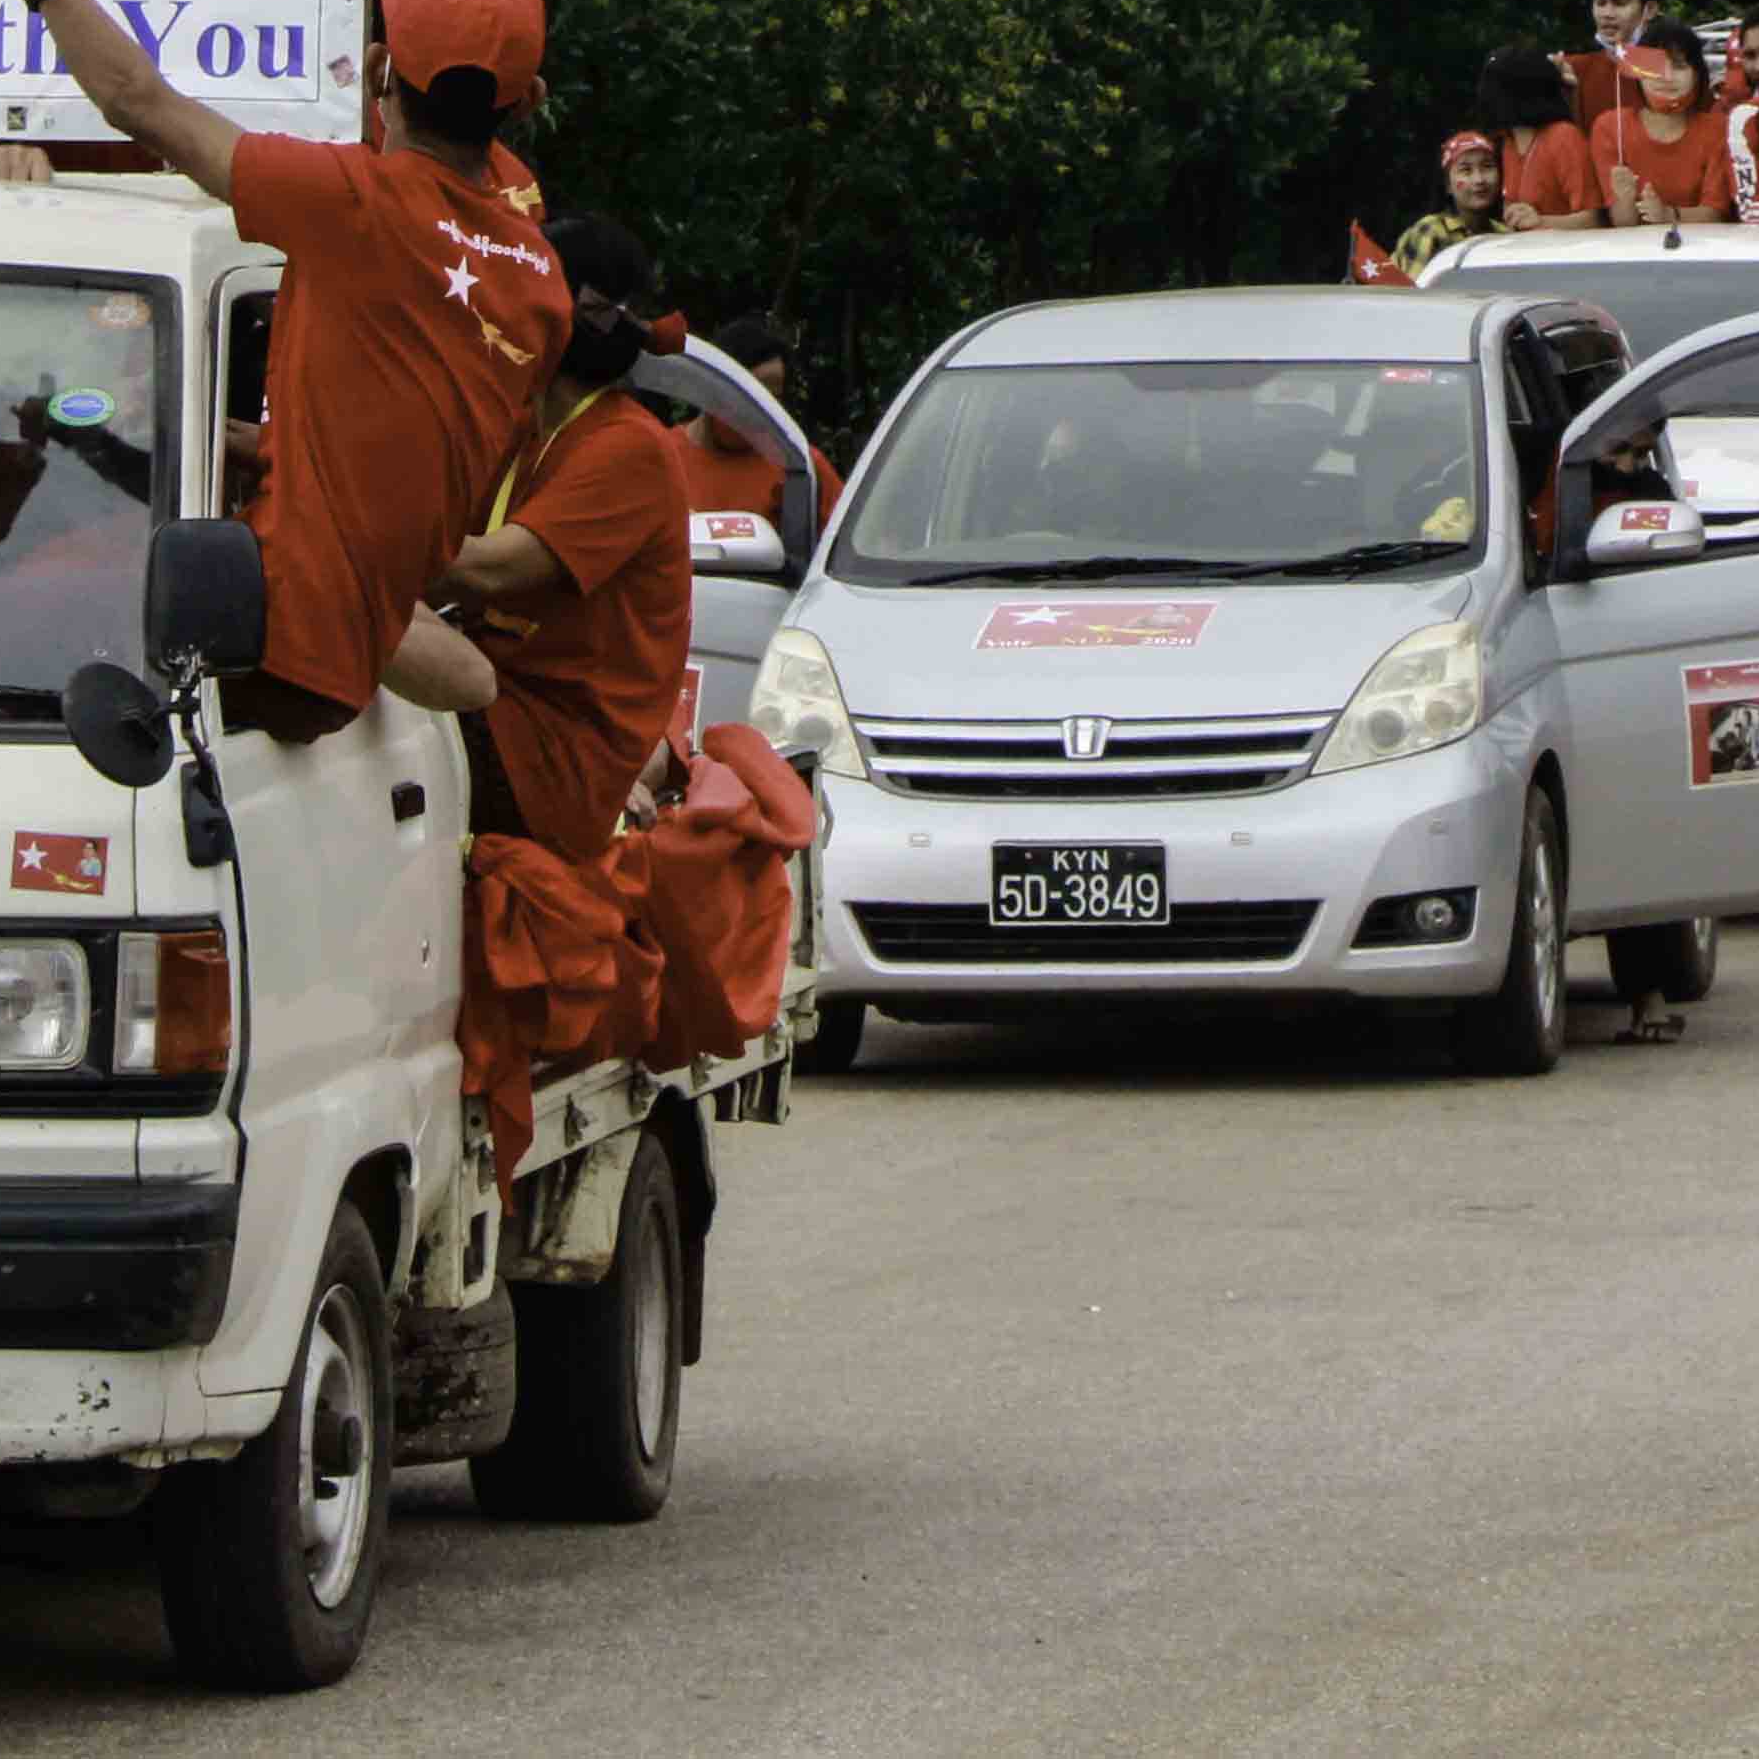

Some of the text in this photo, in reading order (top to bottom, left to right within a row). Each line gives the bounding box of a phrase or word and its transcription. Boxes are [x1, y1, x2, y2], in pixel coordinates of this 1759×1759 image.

[115, 0, 307, 78] You
[1052, 850, 1110, 871] KYN
[999, 873, 1160, 918] 5D-3849
